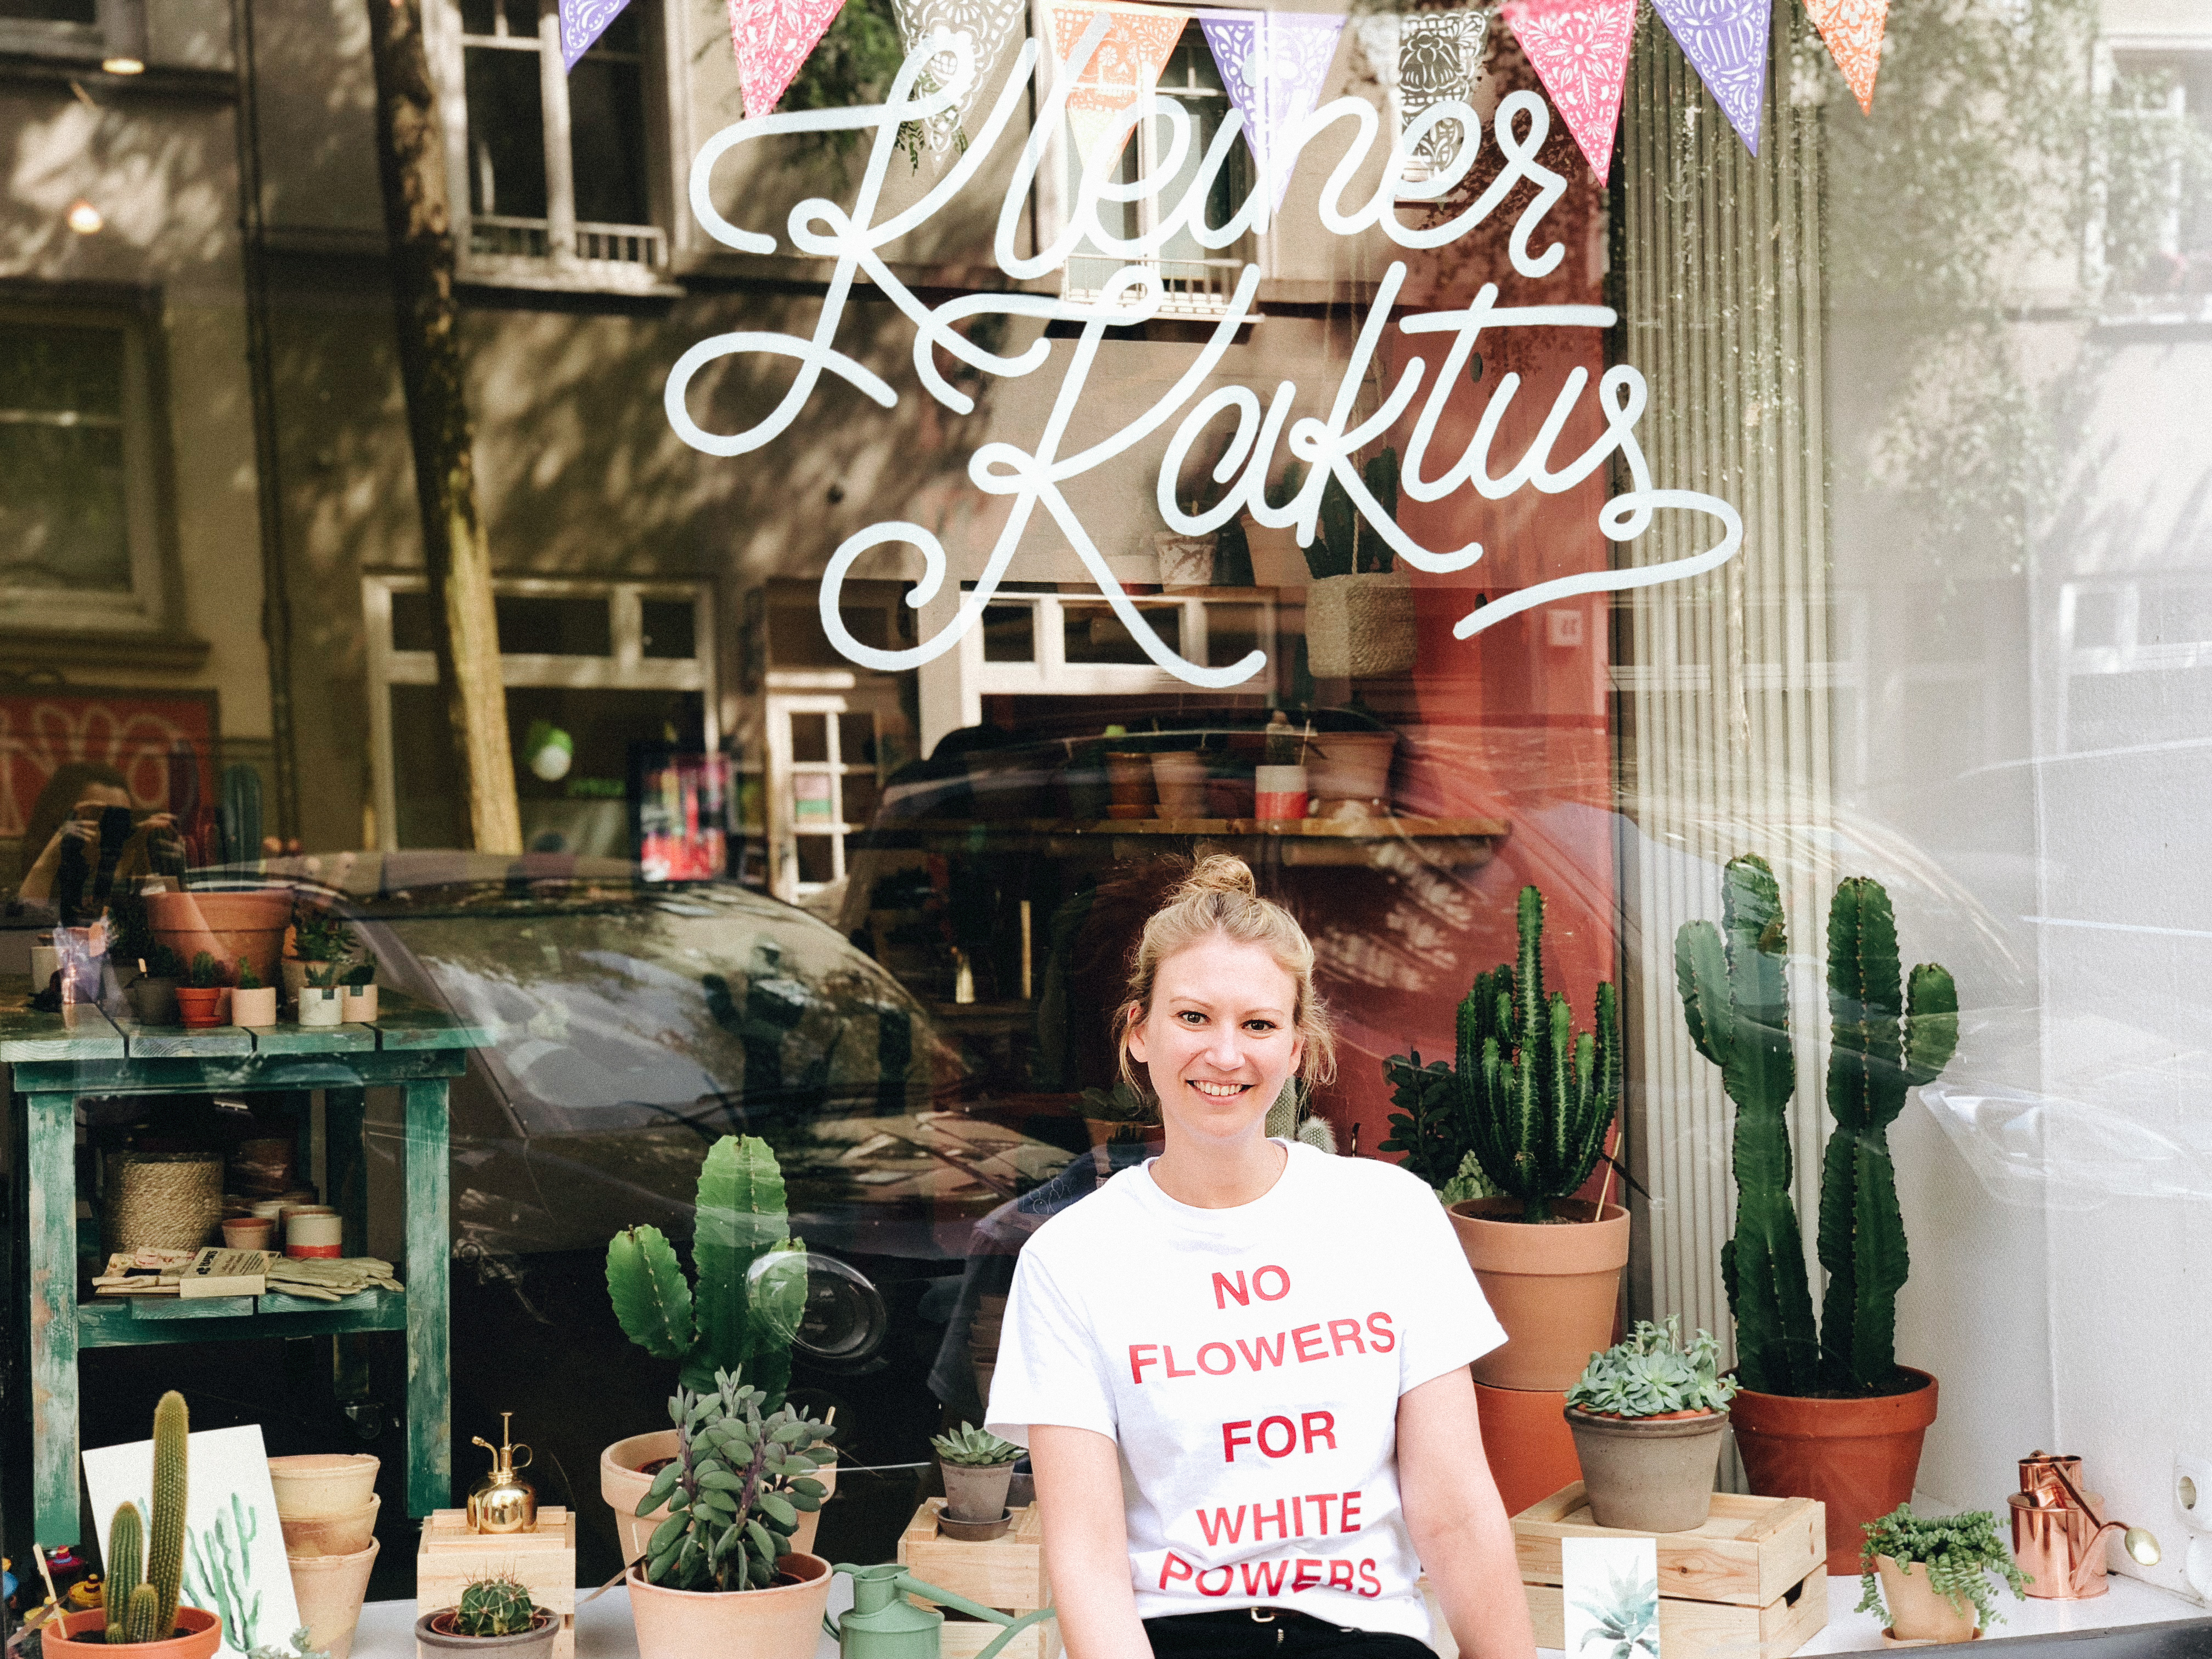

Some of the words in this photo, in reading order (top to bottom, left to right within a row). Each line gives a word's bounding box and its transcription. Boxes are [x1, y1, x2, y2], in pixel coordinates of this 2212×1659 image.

[664, 12, 1566, 457] Kleiner
[820, 261, 1743, 688] Kaktus
[1211, 1265, 1291, 1310] NO
[1128, 1311, 1396, 1385] FLOWERS
[1222, 1410, 1338, 1463] FOR
[1195, 1491, 1362, 1547] WHITE
[1158, 1550, 1382, 1599] POWERS
